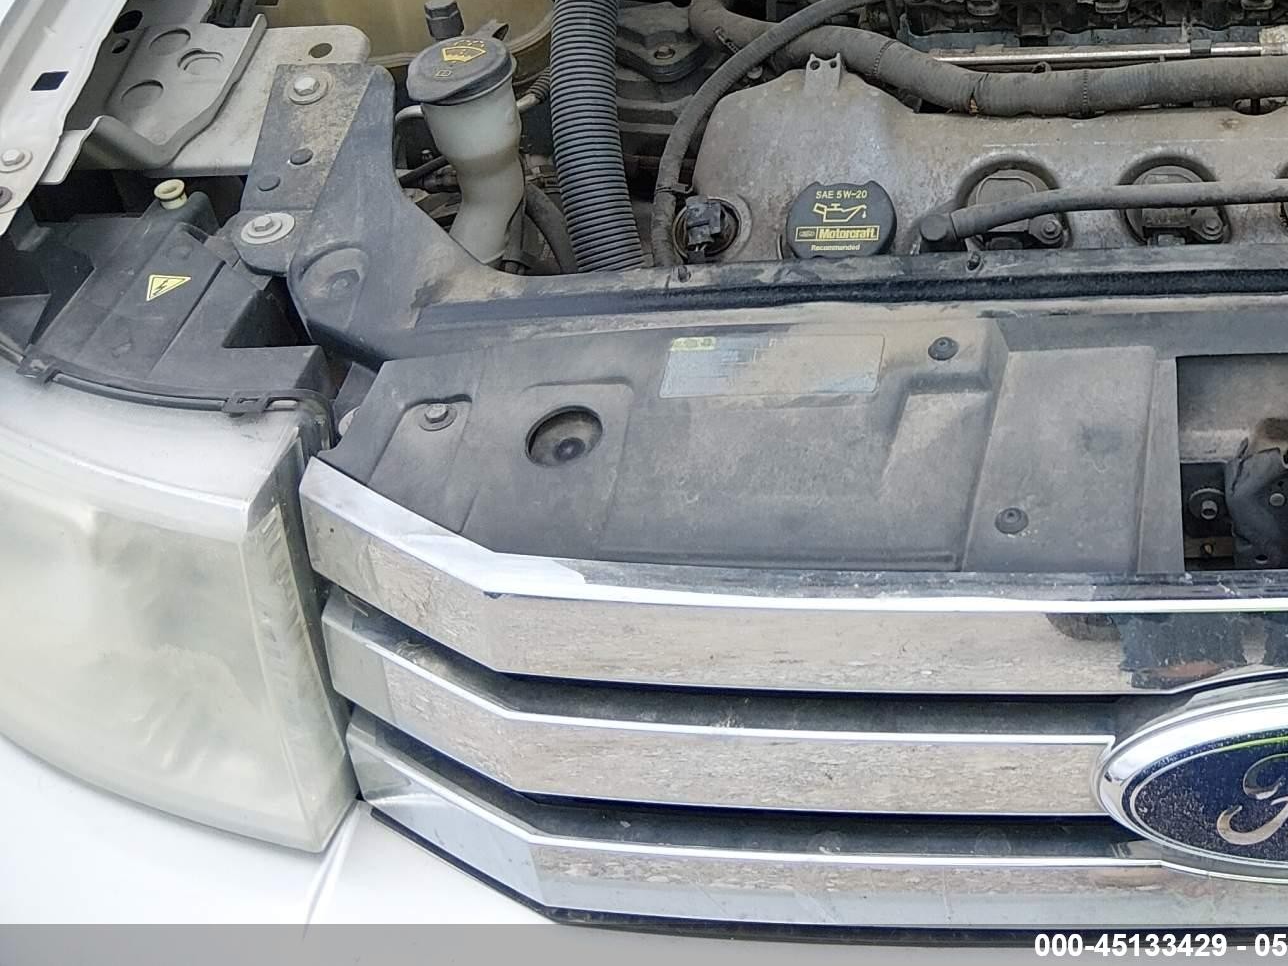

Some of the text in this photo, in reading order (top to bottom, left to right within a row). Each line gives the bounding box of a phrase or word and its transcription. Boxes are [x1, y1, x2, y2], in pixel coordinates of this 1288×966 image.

[815, 189, 868, 199] SAE 5W-20
[819, 227, 876, 240] Motorcraft
